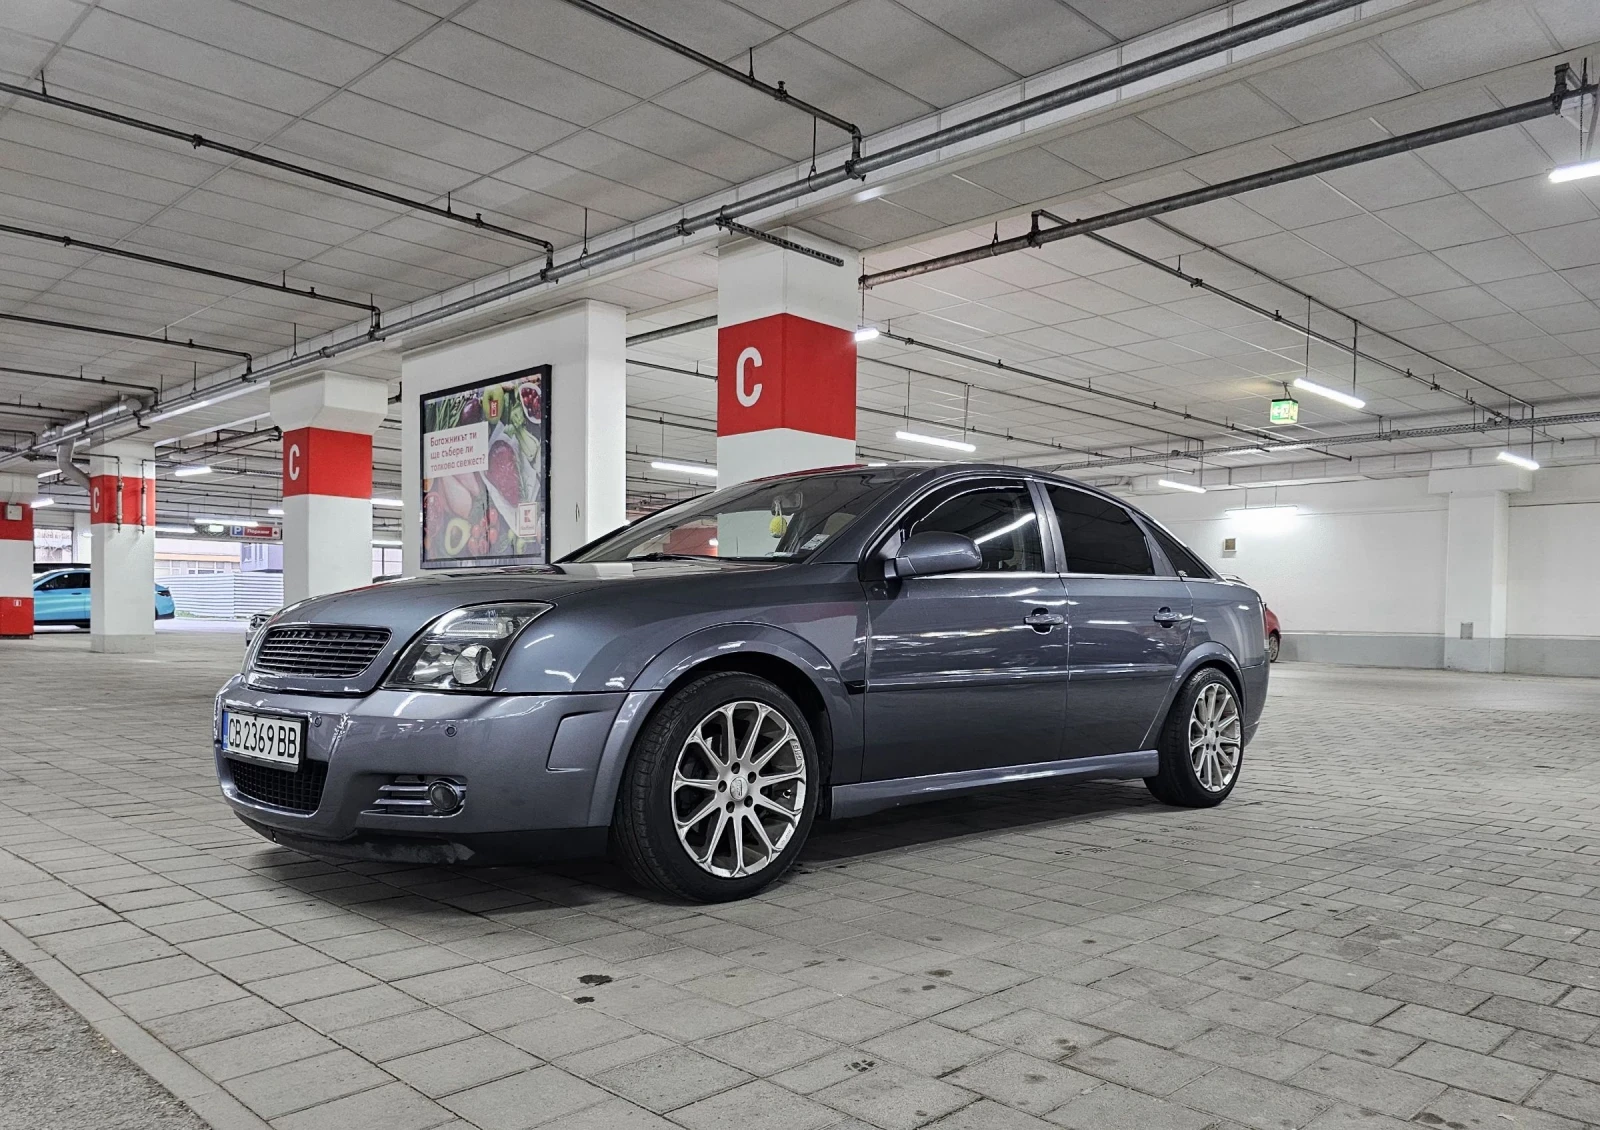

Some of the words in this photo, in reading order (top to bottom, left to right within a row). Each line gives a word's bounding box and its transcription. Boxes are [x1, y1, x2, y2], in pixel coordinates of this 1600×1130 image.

[736, 346, 763, 407] C
[469, 432, 477, 440] ти
[289, 444, 300, 481] C
[430, 452, 440, 460] ще
[441, 446, 464, 458] събере
[456, 453, 486, 468] свежест?
[93, 487, 100, 514] C
[243, 721, 275, 755] 2369
